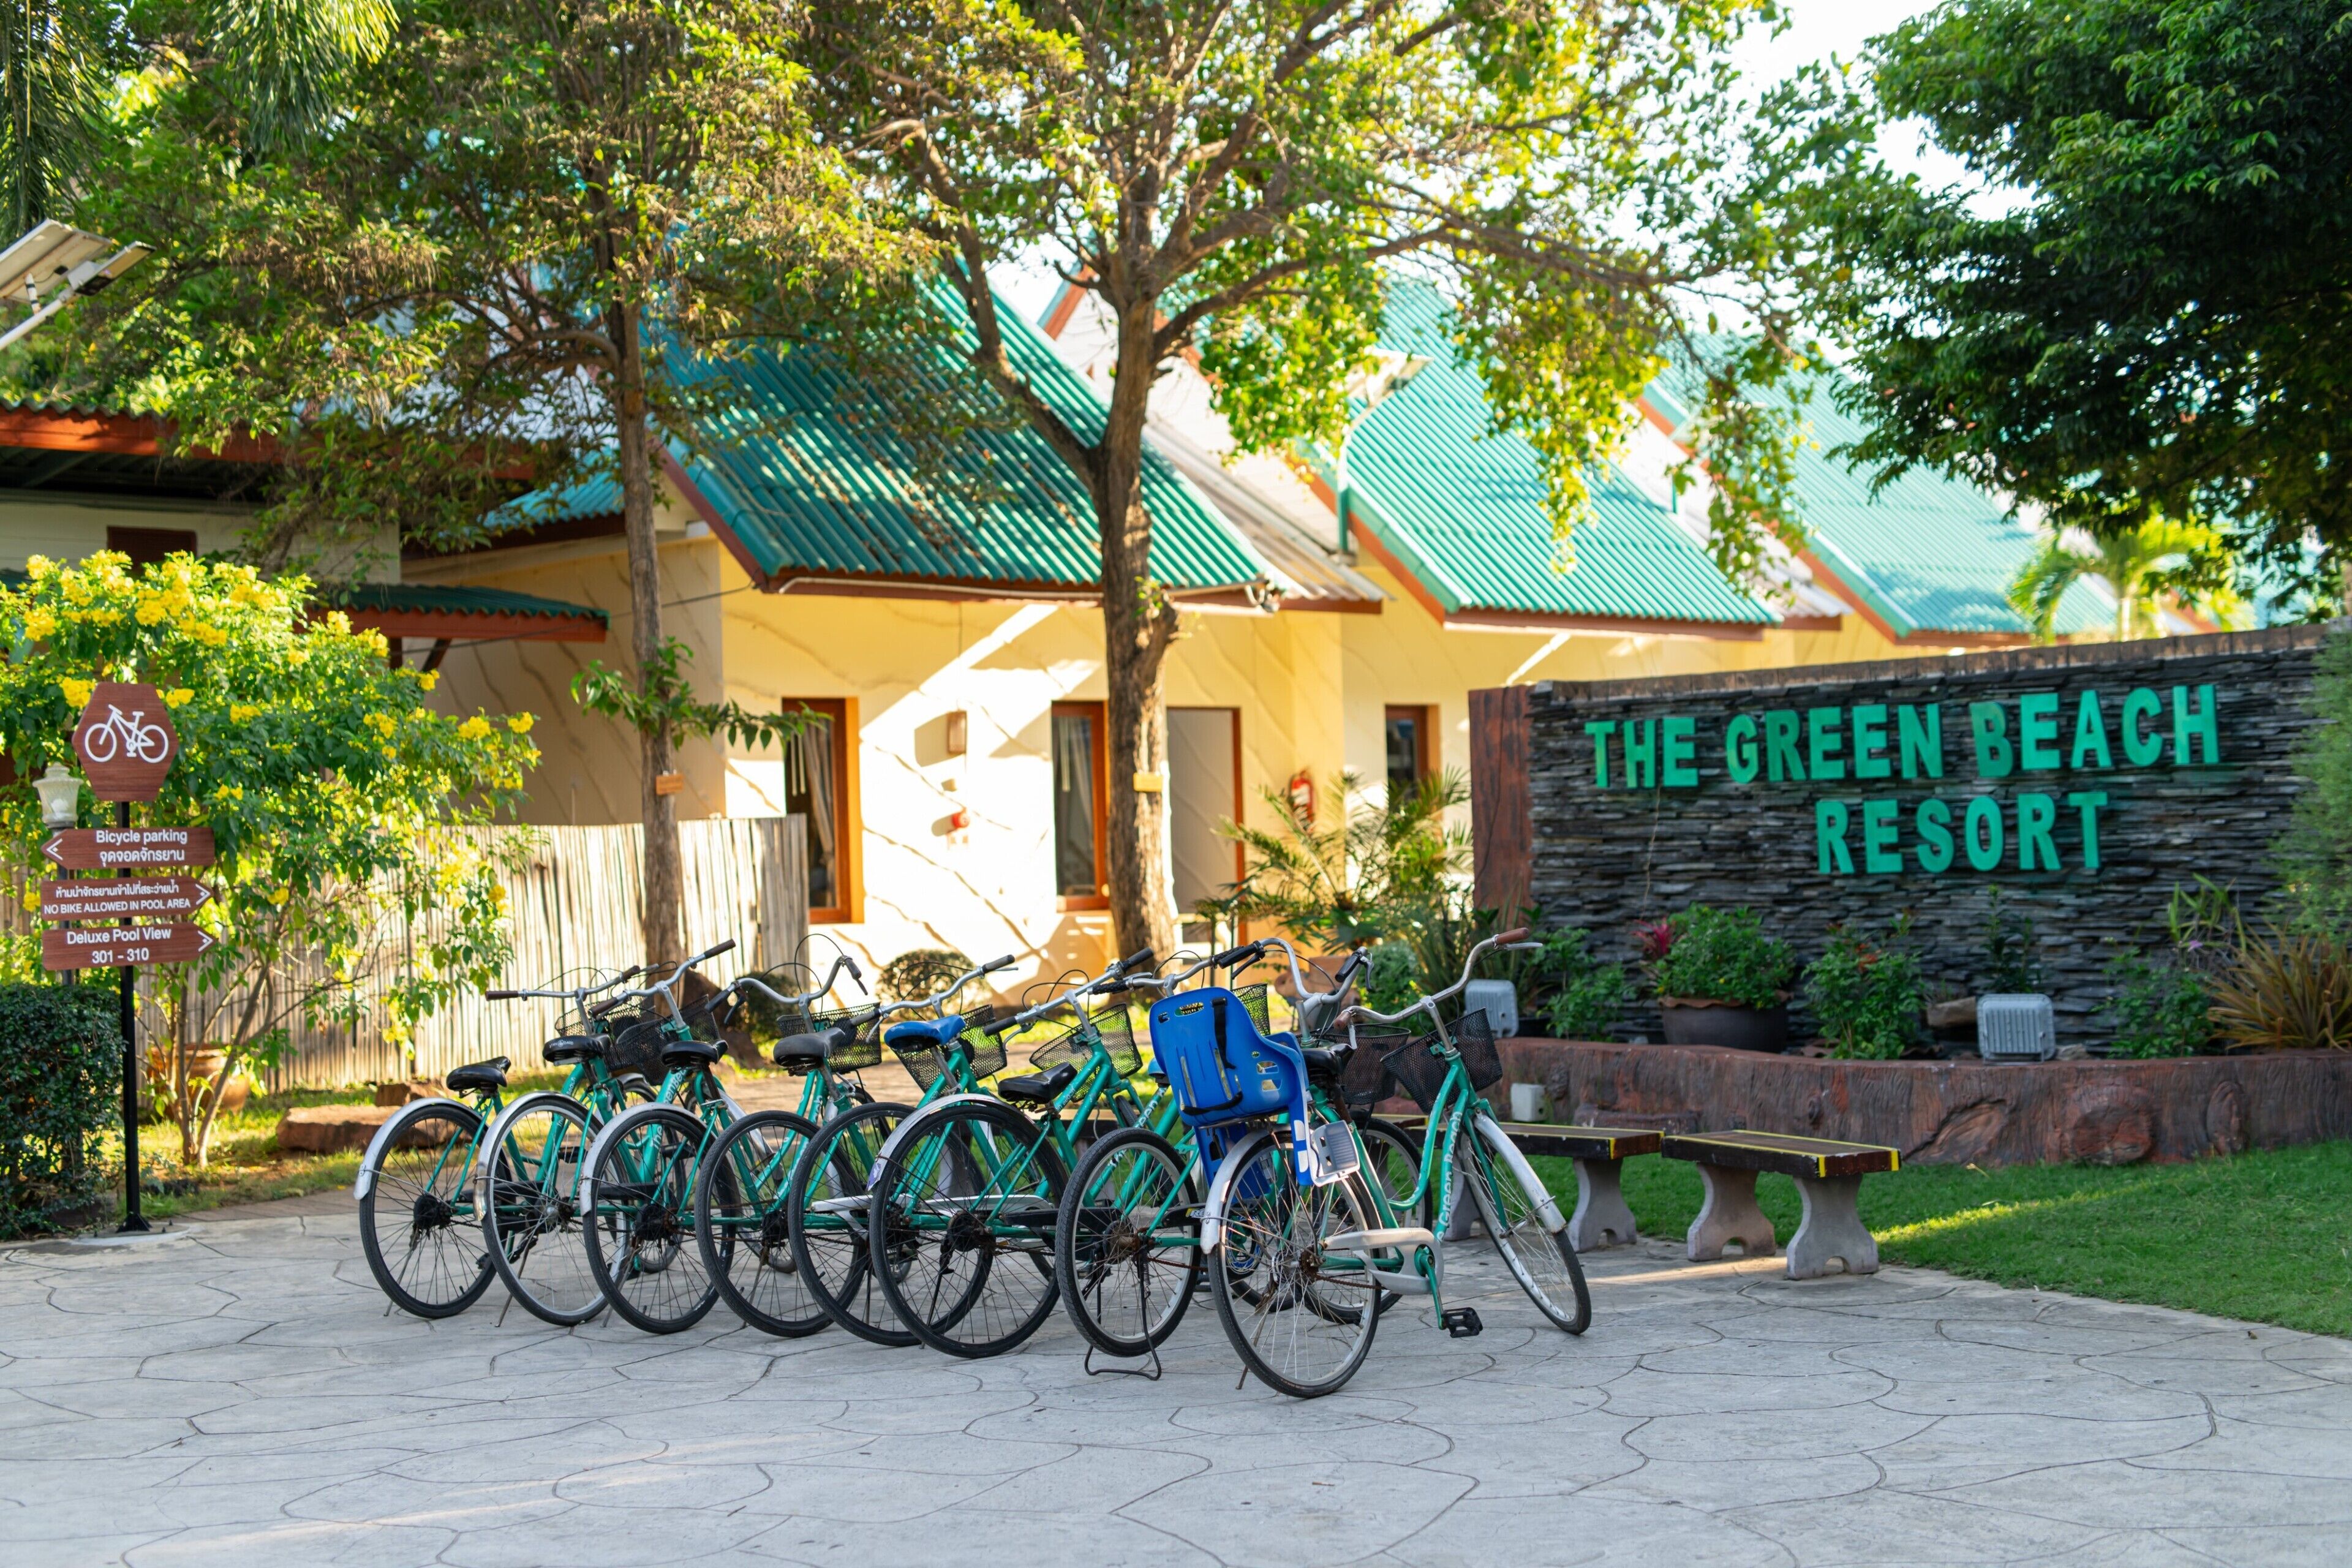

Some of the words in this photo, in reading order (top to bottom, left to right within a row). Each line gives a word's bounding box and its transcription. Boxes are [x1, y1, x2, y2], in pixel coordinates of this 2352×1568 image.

[1585, 717, 1698, 788] THE
[1726, 704, 1943, 784] GREEN
[1969, 684, 2220, 777] BEACH
[96, 829, 141, 846] Bicycle
[143, 829, 187, 845] parking
[1815, 791, 2108, 874] RESORT
[99, 847, 185, 867] จุดจอดจักรยาน
[44, 905, 59, 914] NO
[61, 903, 81, 914] BIKE
[84, 901, 128, 913] ALLOWED
[130, 900, 138, 910] IN
[140, 899, 165, 910] POOL
[167, 898, 191, 908] AREA
[67, 931, 110, 944] Deluxe
[113, 929, 140, 942] Pool
[143, 927, 172, 940] View
[92, 950, 113, 964] 301
[127, 948, 149, 962] 310
